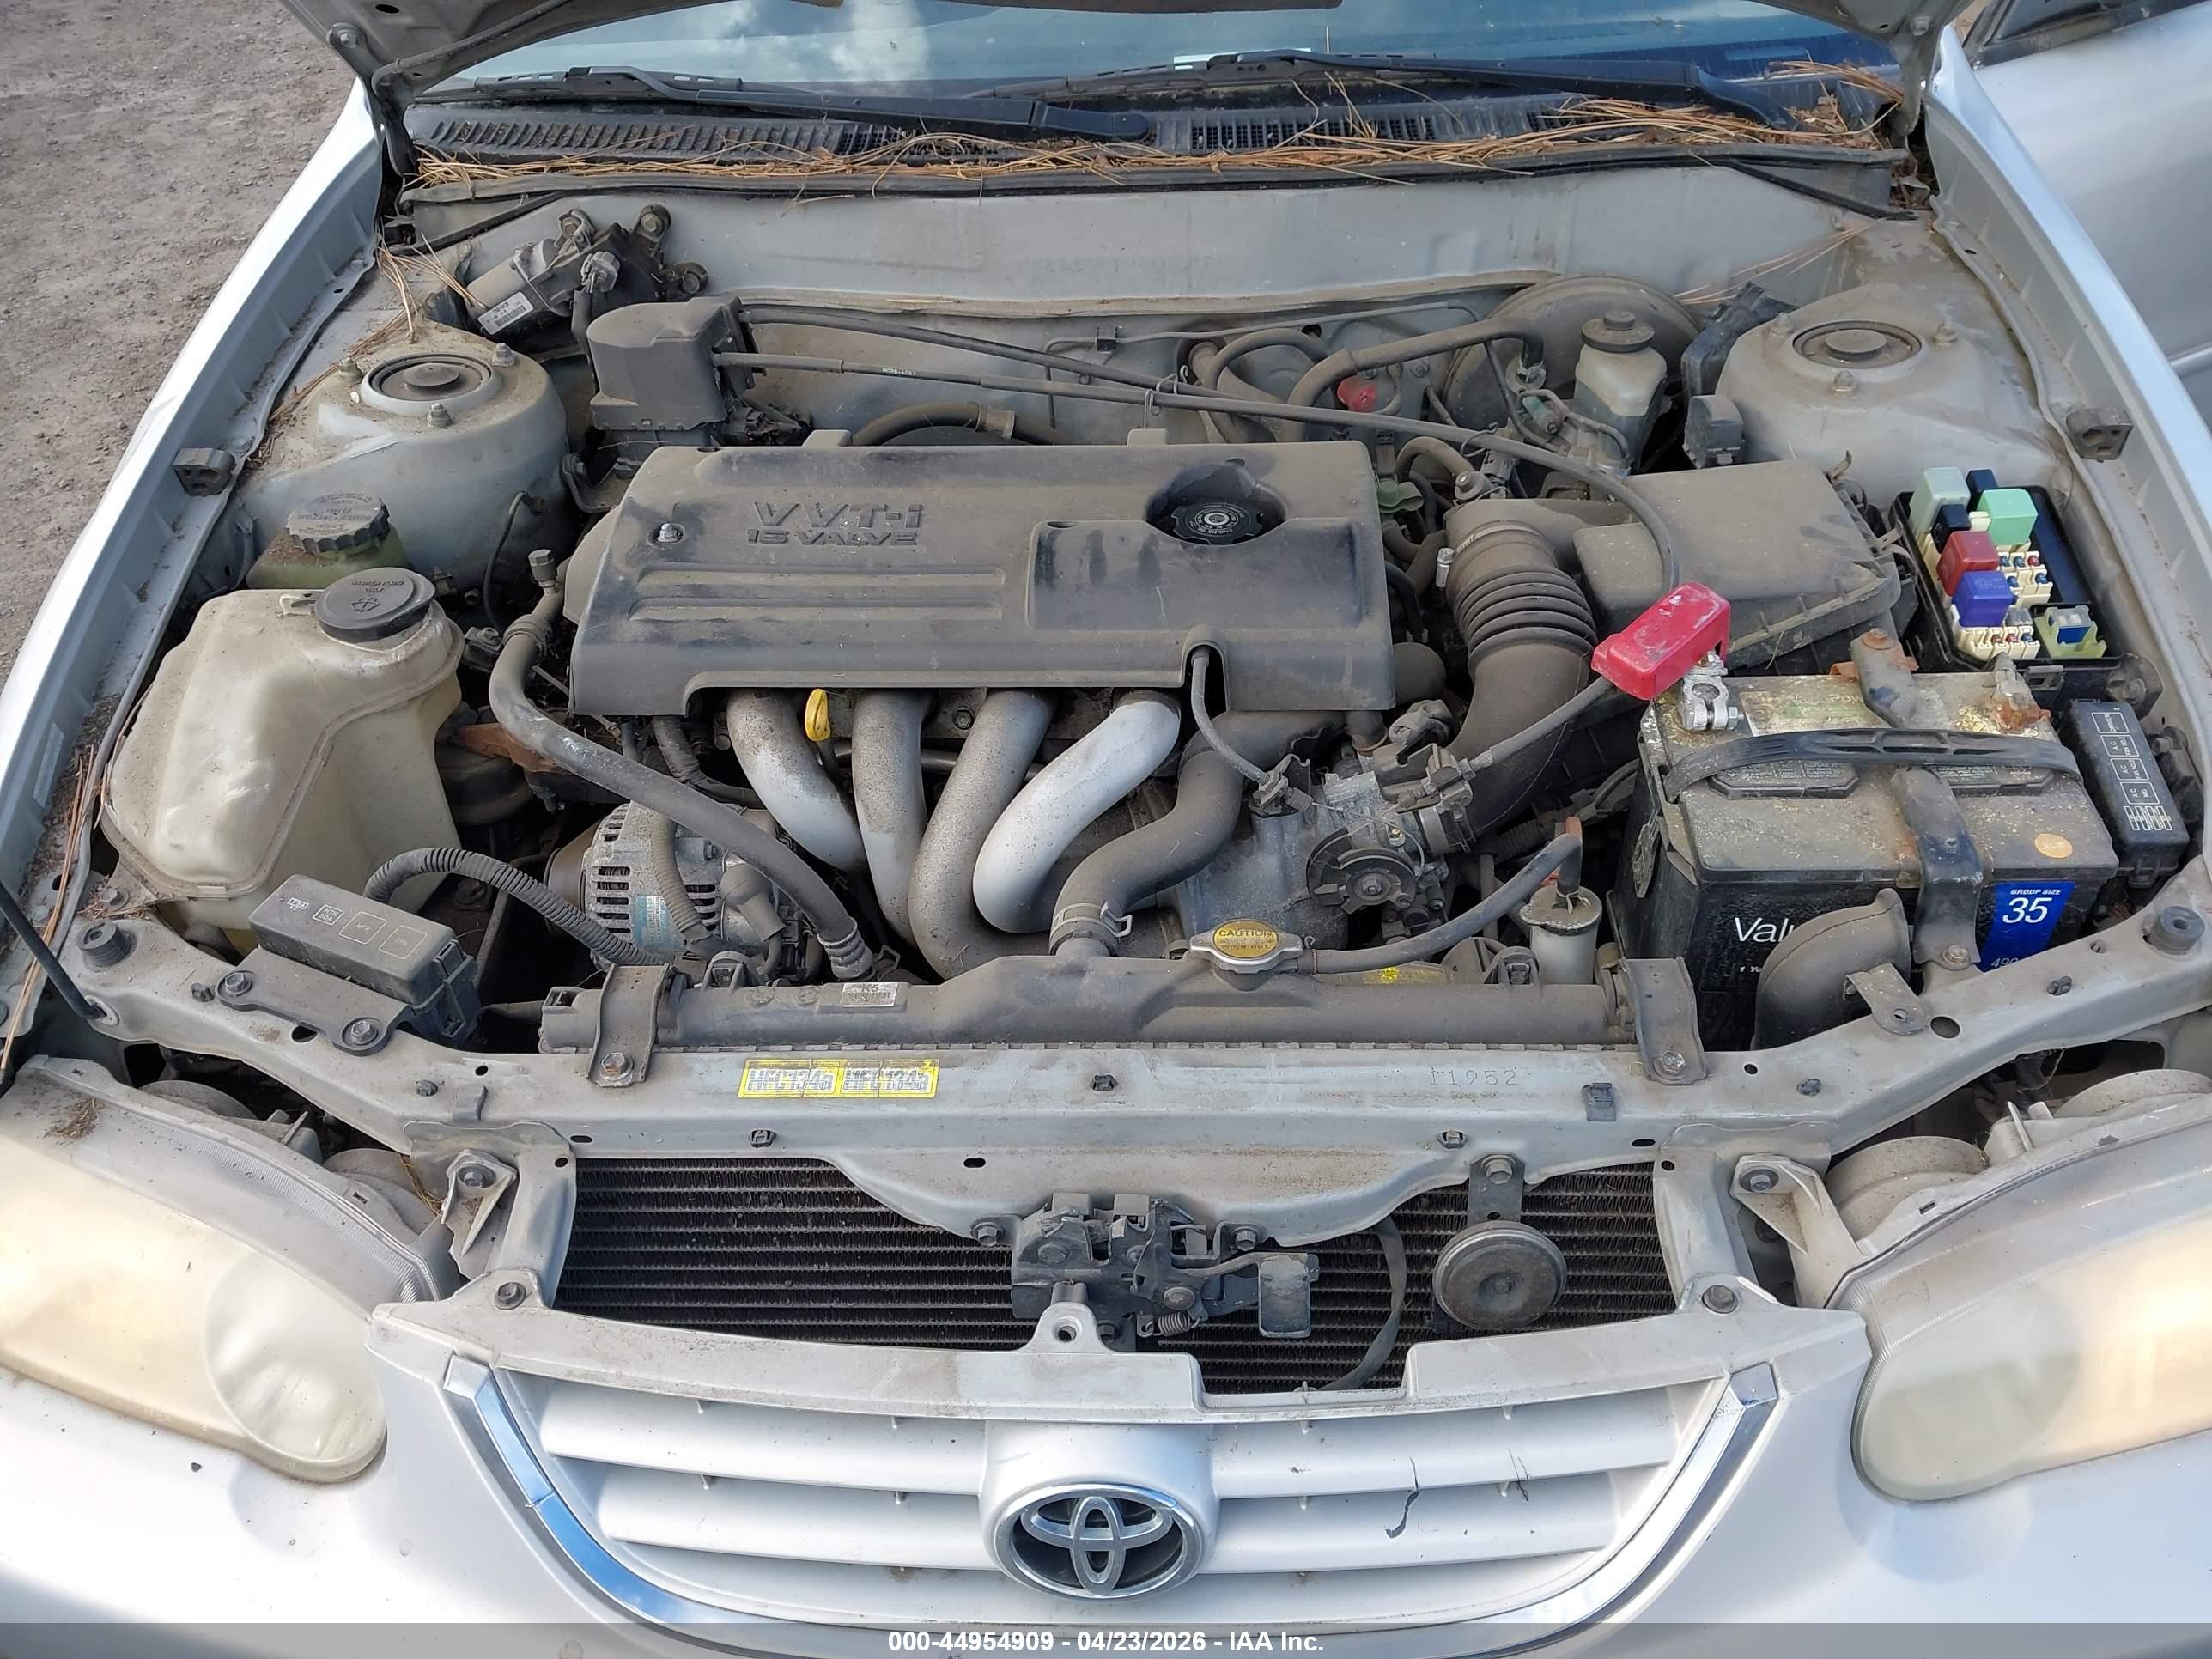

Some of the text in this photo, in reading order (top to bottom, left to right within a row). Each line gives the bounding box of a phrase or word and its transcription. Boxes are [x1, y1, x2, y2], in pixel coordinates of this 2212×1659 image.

[747, 529, 918, 546] 16 VALVE
[2002, 897, 2052, 923] 35
